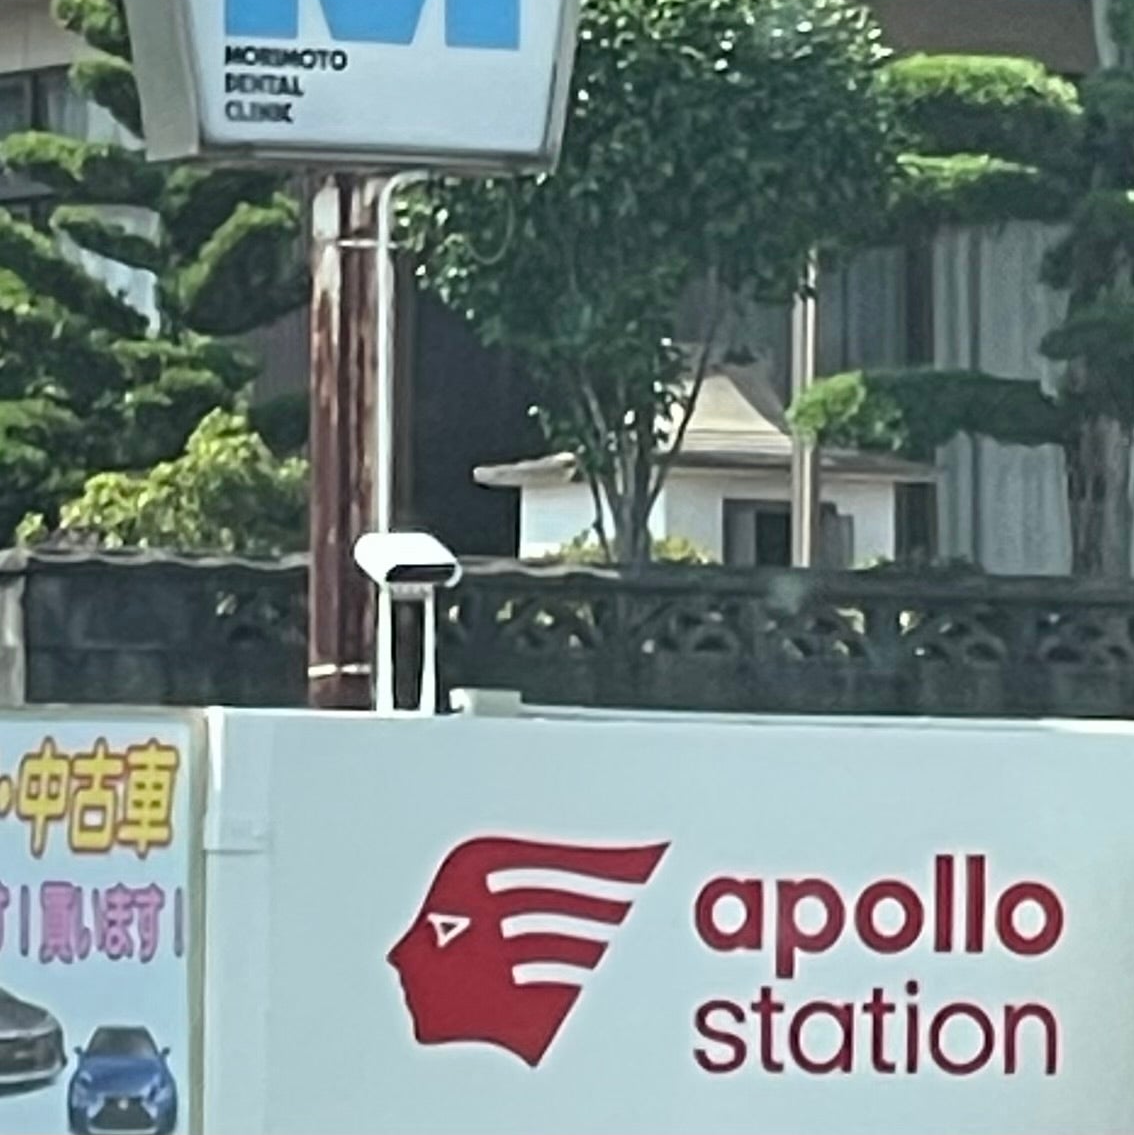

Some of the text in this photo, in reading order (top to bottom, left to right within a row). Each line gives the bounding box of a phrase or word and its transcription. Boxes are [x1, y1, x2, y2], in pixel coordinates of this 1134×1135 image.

[224, 45, 348, 71] MORIMOTO
[224, 72, 305, 97] DENTAL
[224, 100, 294, 124] CLINIC
[693, 853, 1065, 979] apollo
[692, 979, 1058, 1075] station
